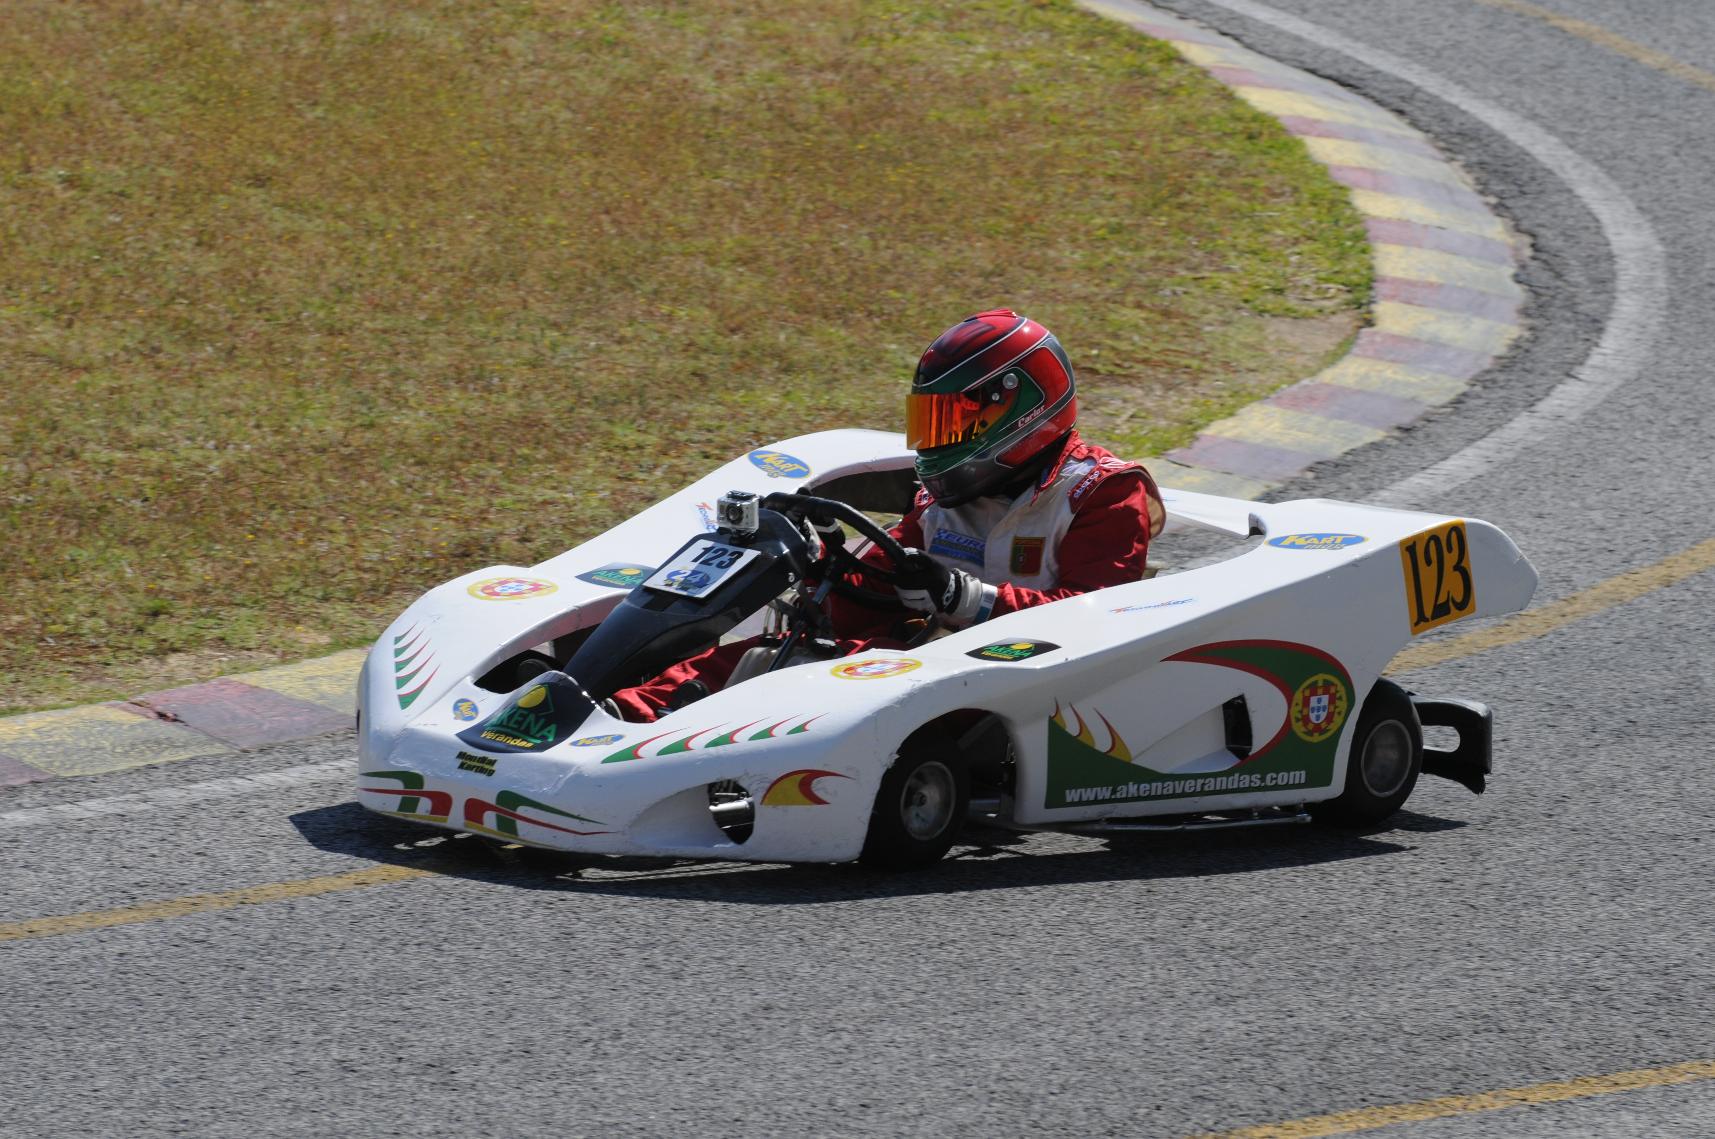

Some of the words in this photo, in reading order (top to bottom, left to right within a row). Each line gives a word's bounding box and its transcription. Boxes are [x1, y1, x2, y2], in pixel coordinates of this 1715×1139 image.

[690, 546, 744, 569] 123
[1404, 526, 1473, 628] 123
[1065, 769, 1307, 802] www.akenaverandas.com
